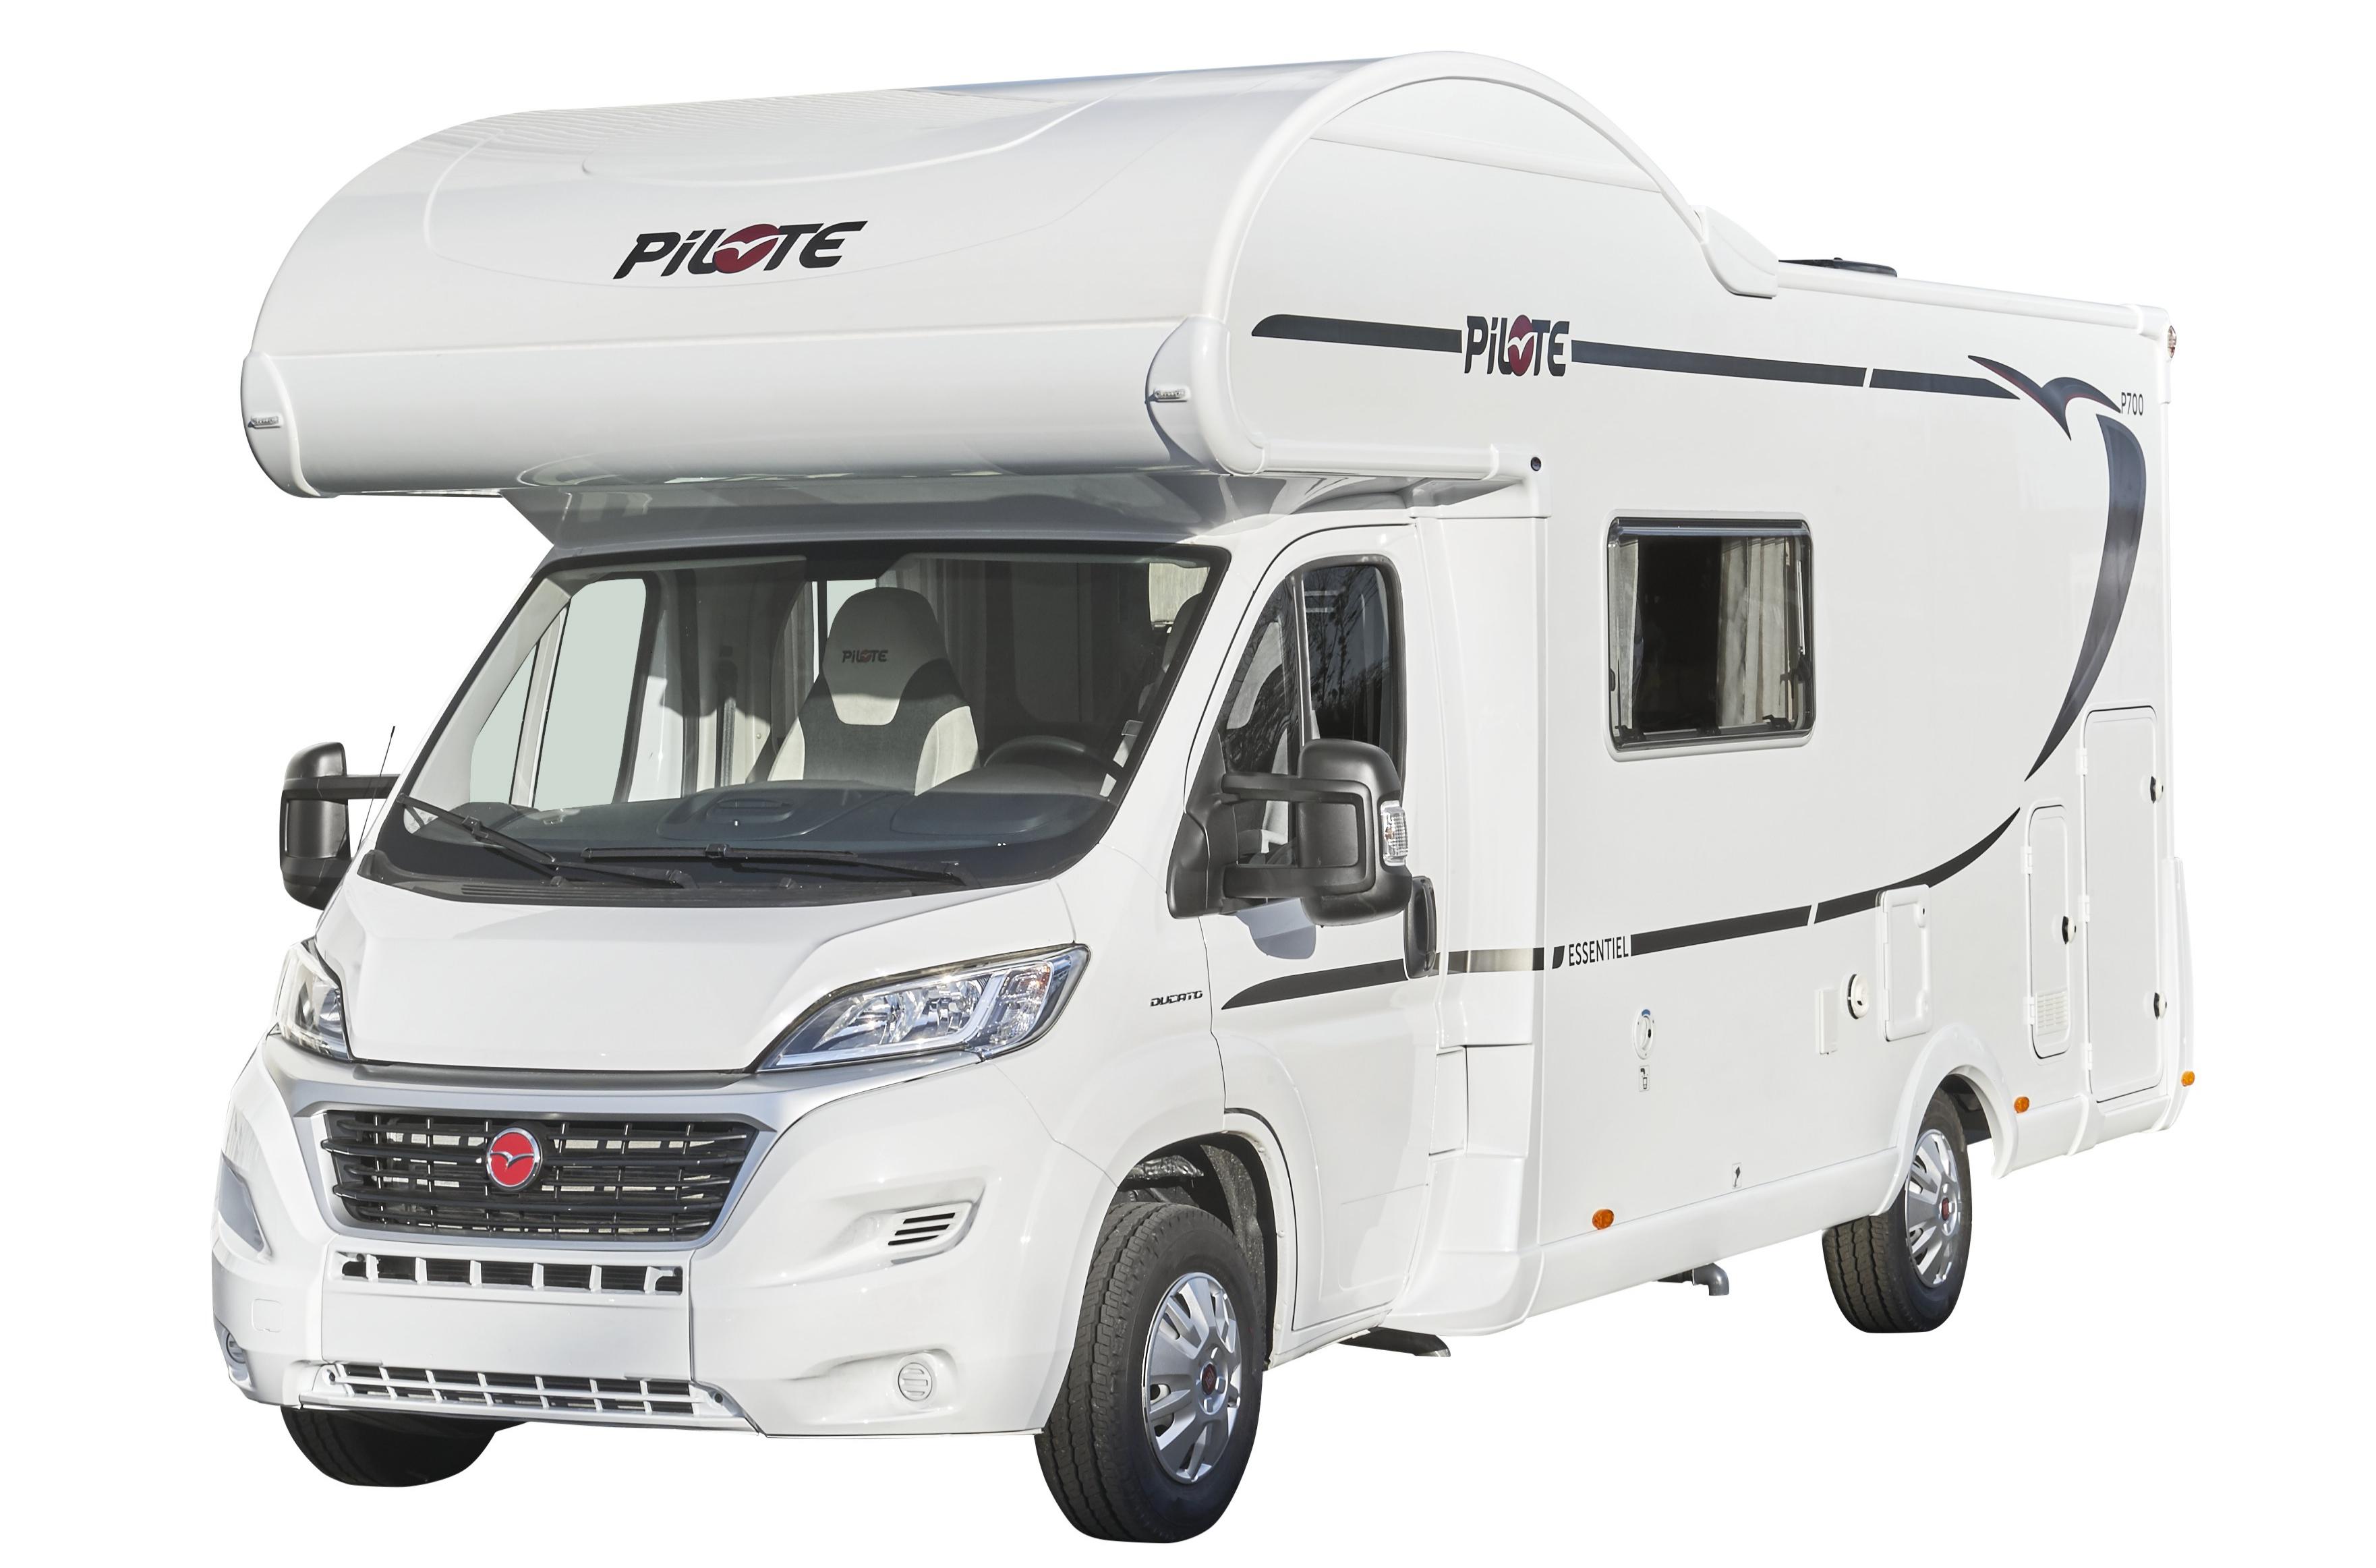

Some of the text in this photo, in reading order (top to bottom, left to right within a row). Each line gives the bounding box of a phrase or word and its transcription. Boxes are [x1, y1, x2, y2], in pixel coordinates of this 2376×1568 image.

[2121, 392, 2143, 415] P700
[1569, 936, 1629, 966] ESSENTIEL
[1151, 990, 1203, 1007] DUCATO
